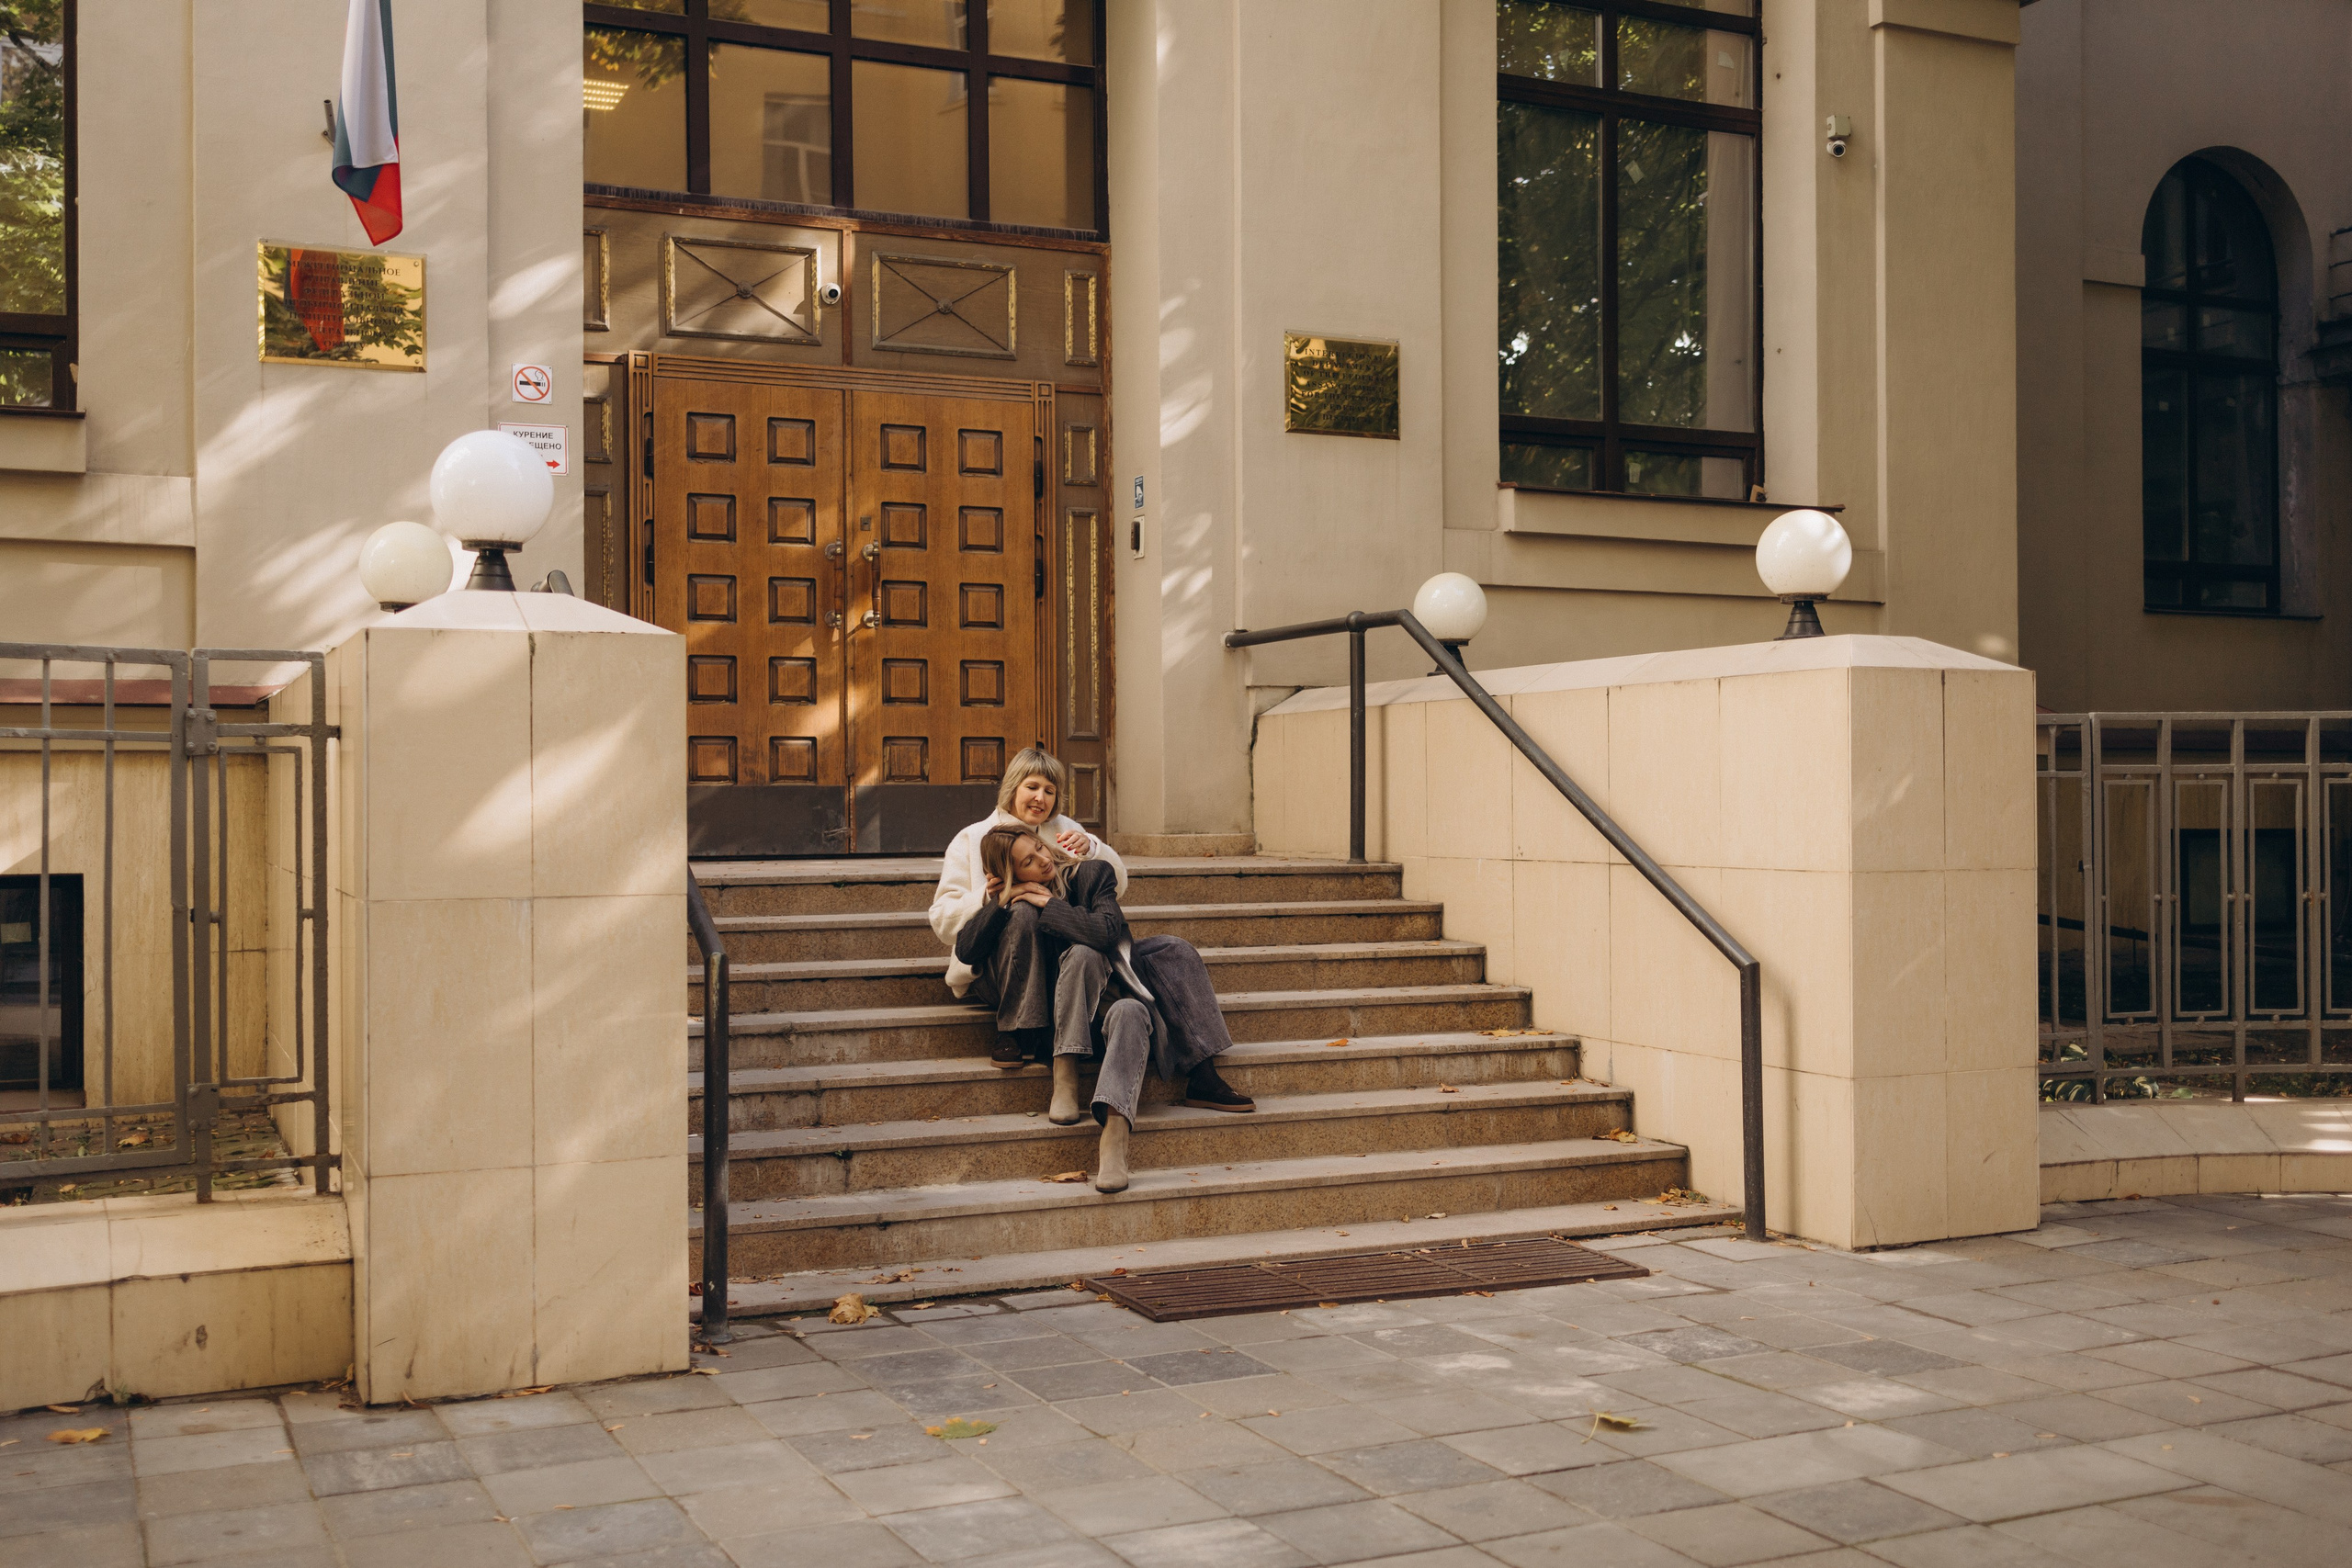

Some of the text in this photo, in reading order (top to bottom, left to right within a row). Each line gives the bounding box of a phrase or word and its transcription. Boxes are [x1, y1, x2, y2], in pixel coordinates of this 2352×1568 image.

[1305, 348, 1383, 361] INTERREGIONAL
[1312, 359, 1377, 371] DEPARTMENT
[1301, 390, 1320, 399] FOR
[513, 431, 554, 439] КУРЕНИЕ
[529, 442, 561, 450] ЕЩЕНО
